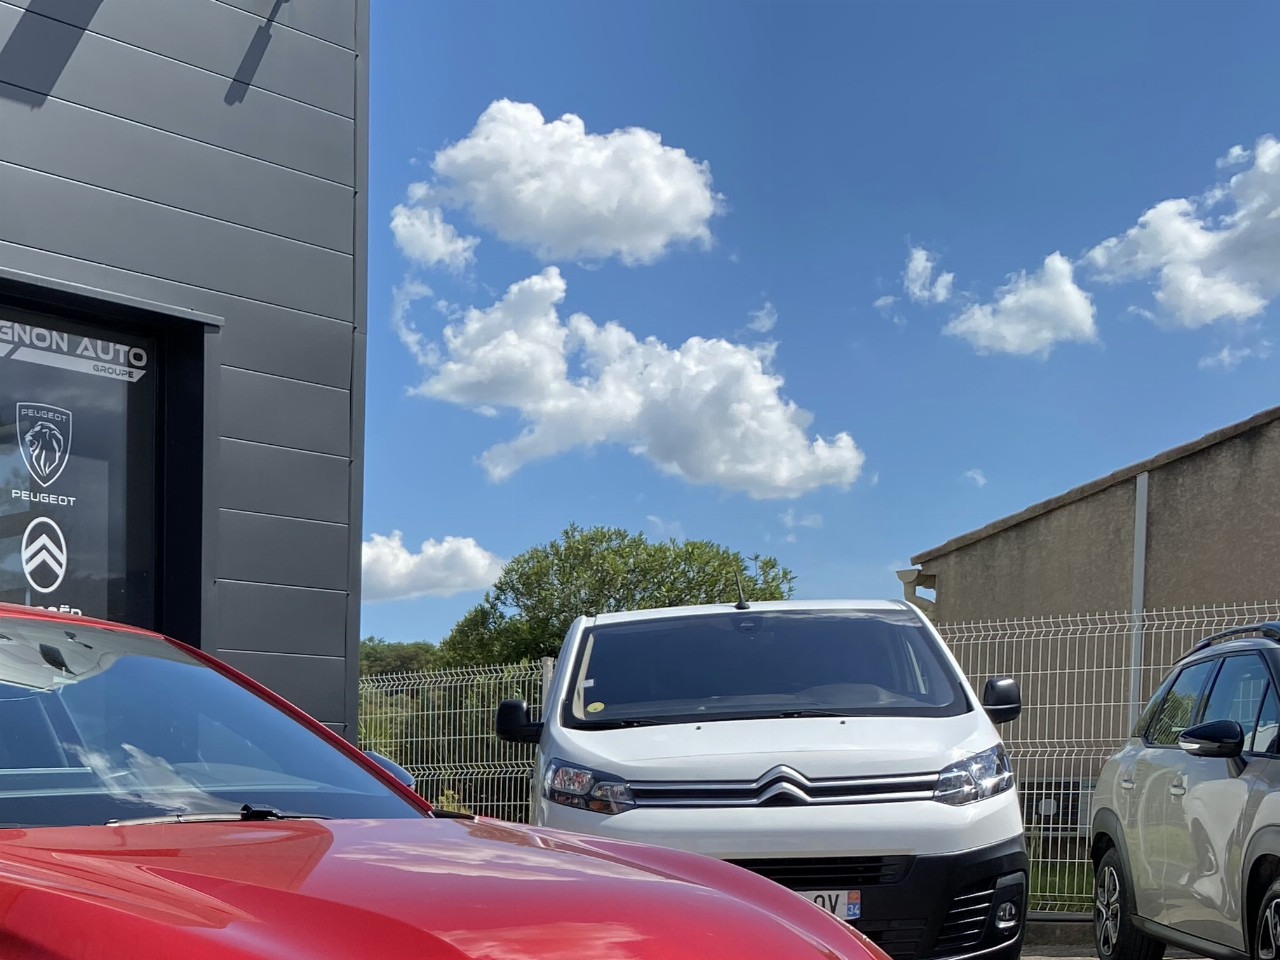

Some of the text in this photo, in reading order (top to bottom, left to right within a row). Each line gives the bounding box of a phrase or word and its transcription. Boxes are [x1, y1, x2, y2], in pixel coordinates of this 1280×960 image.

[75, 336, 148, 368] AUTO
[92, 363, 135, 380] GROUPE
[21, 408, 68, 423] PEUGEOT
[11, 488, 77, 507] PEUGEOT
[847, 904, 860, 915] 34
